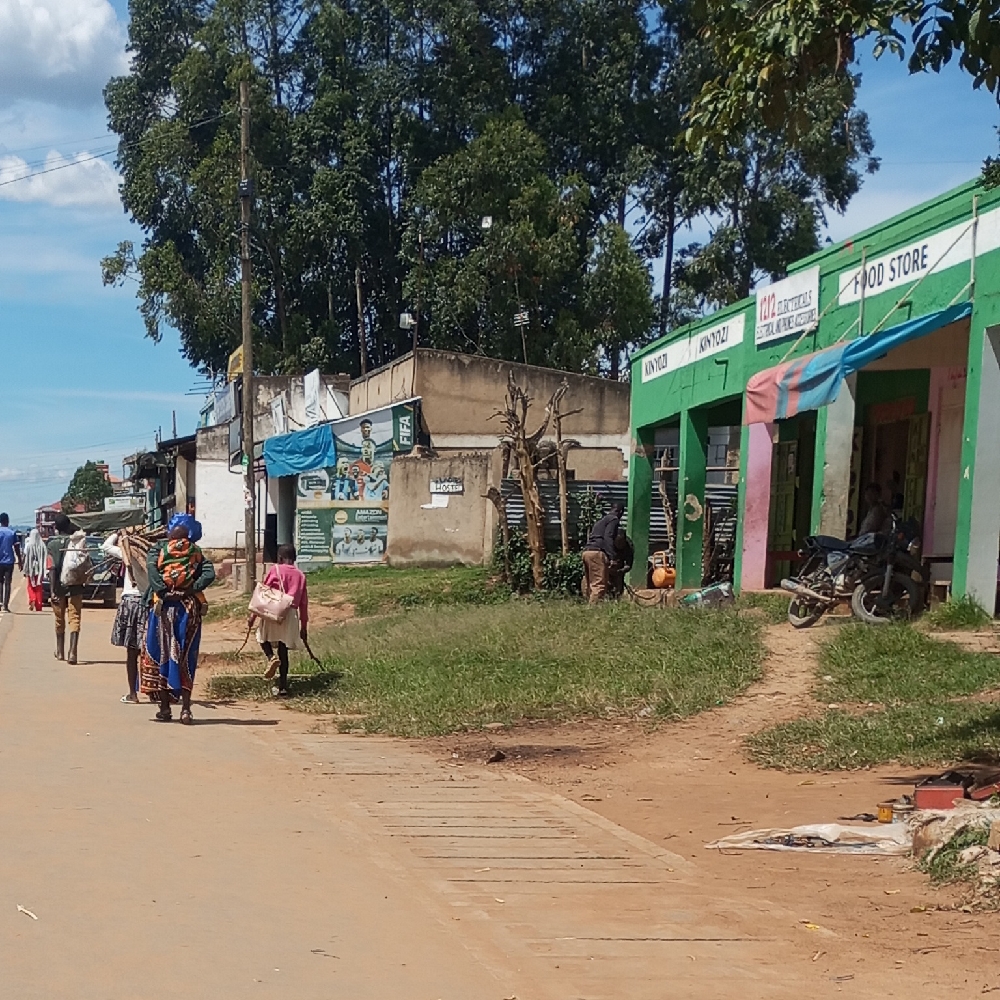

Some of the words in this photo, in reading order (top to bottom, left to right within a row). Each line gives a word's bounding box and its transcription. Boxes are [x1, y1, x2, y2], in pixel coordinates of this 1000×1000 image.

[854, 262, 884, 294] FOOD
[889, 244, 928, 281] STORE
[699, 325, 729, 353] KINYOZI
[644, 352, 668, 376] KINYOZI
[399, 415, 411, 446] FIFA
